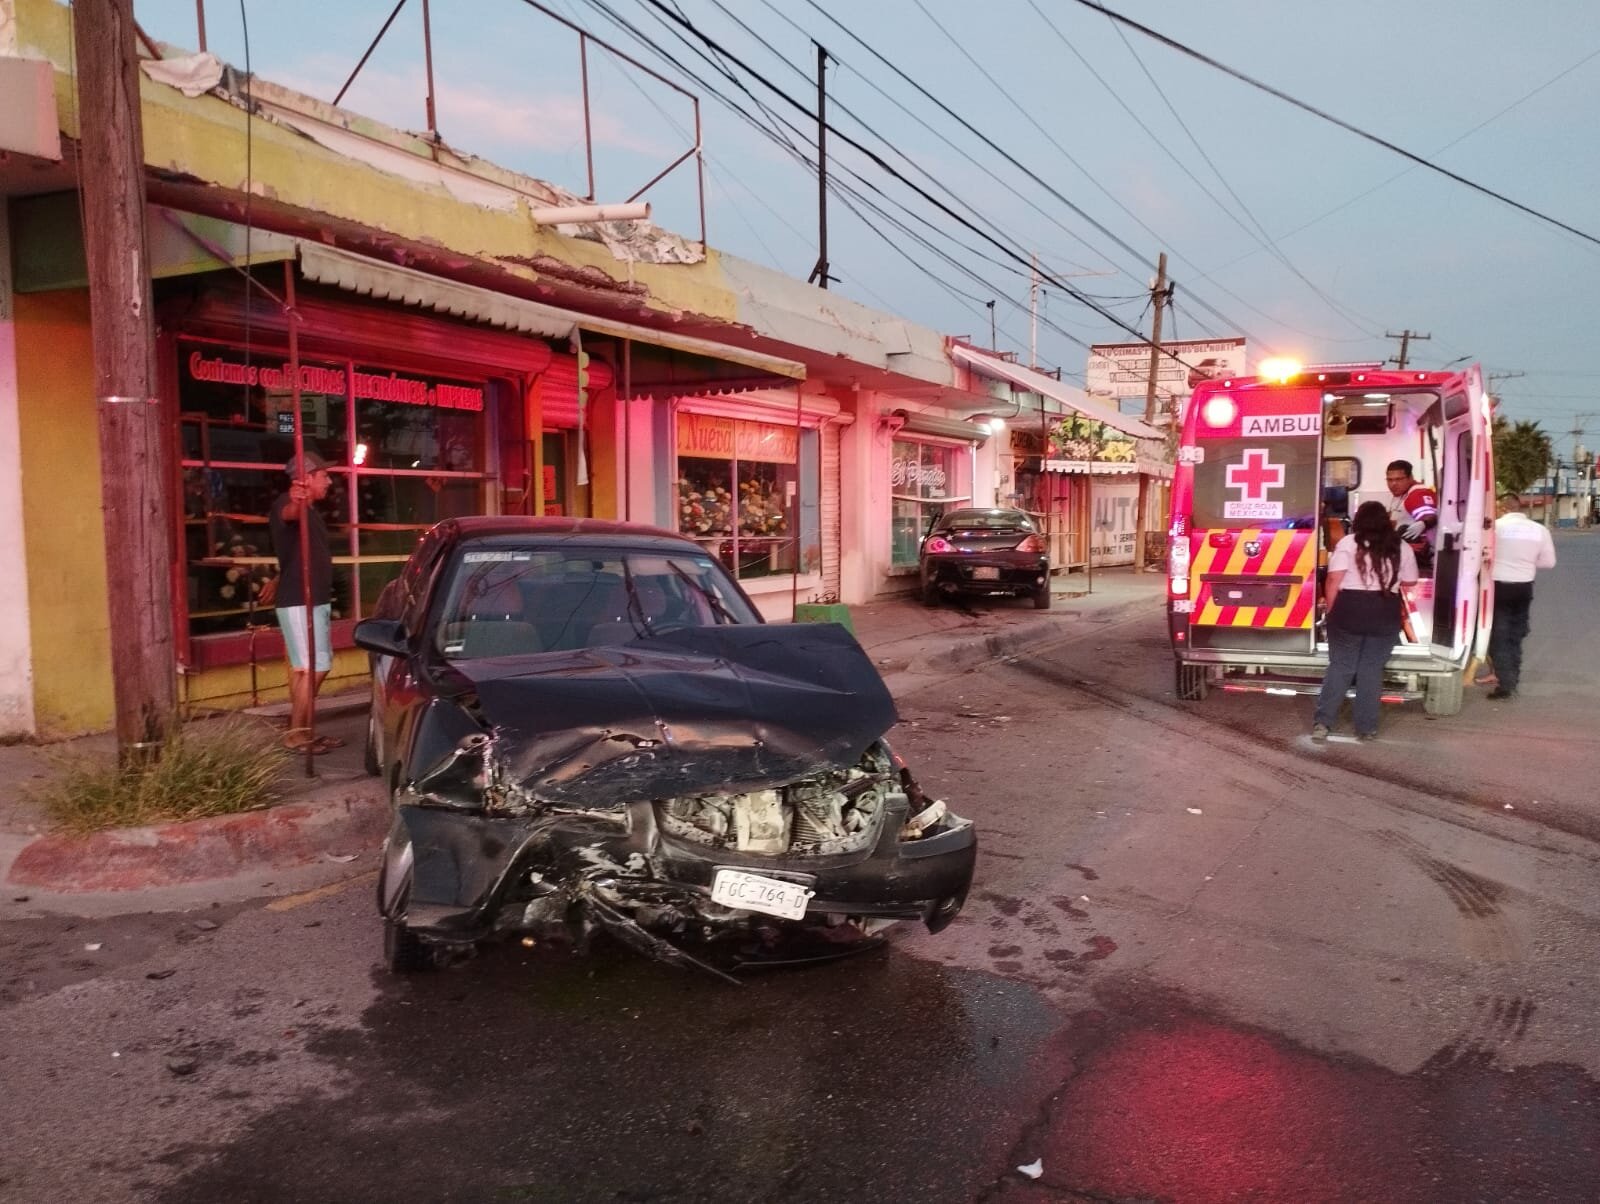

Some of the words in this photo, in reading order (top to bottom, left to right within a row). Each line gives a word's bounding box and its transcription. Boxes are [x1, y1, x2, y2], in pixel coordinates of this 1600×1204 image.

[190, 351, 258, 386] Contamos
[260, 367, 281, 388] con
[283, 363, 346, 395] FCTURAS
[428, 389, 437, 406] o
[437, 384, 483, 411] IMPRESAS
[686, 414, 732, 453] Nueva
[1249, 416, 1320, 433] AMBUL
